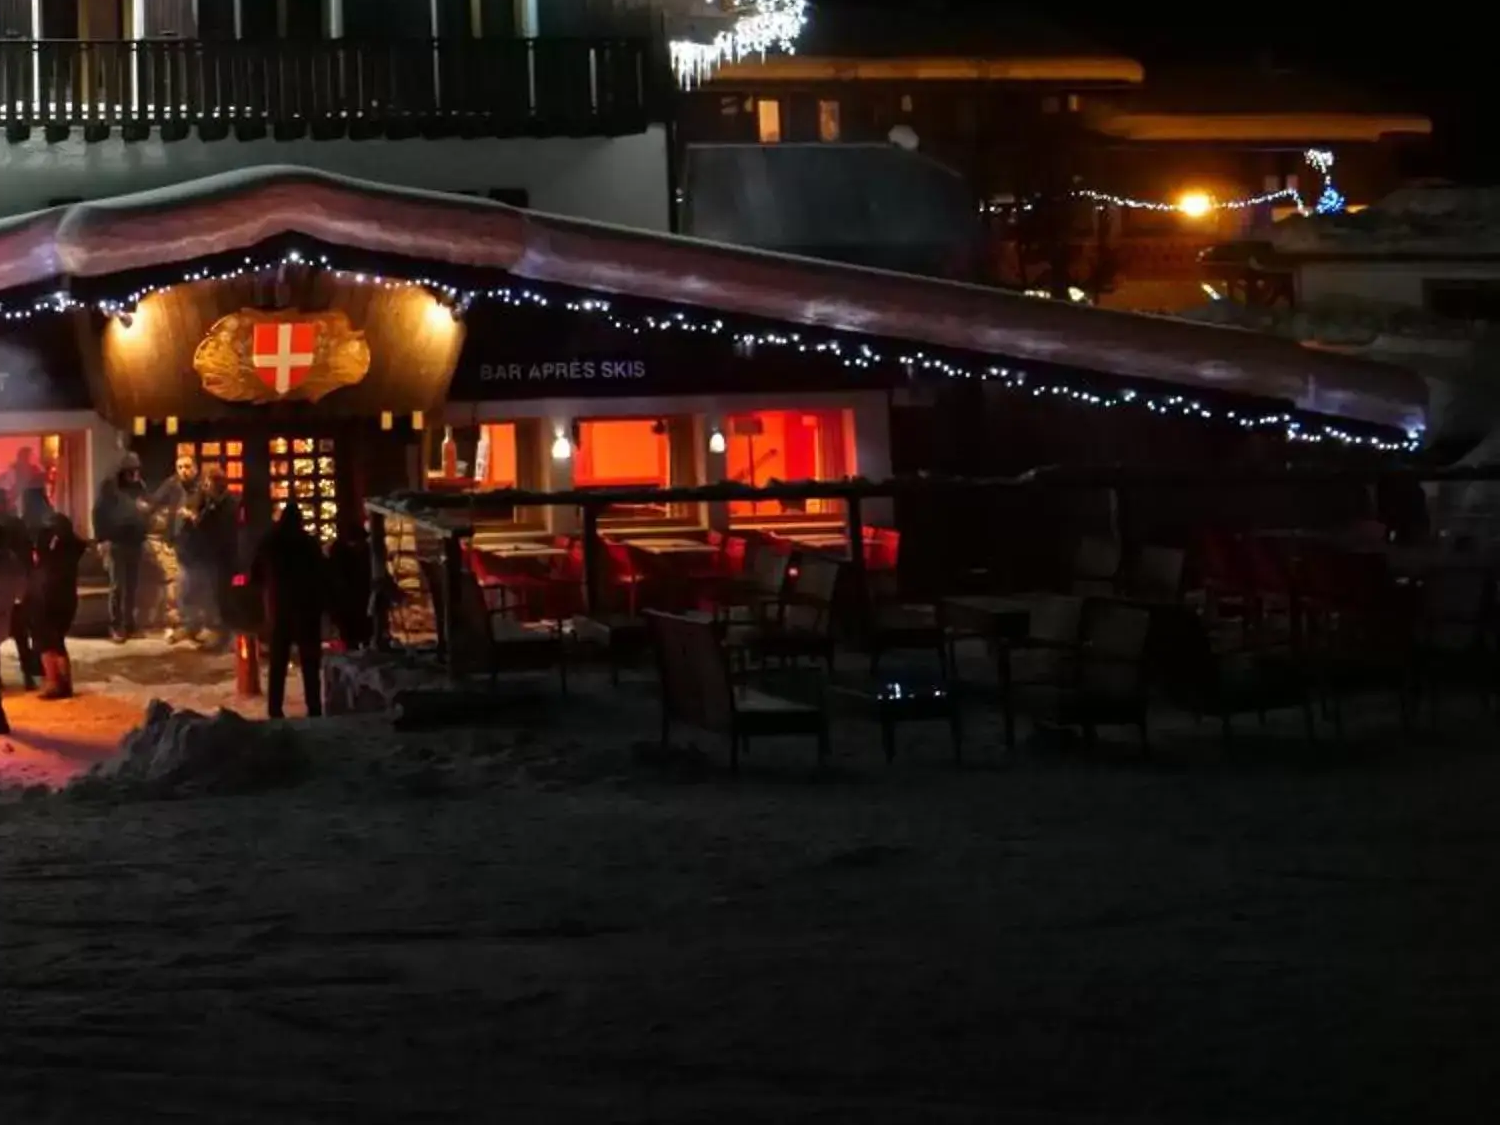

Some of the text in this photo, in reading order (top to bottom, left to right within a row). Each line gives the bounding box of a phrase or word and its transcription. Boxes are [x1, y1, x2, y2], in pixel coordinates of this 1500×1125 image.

[479, 357, 646, 382] BAR APRÈS SKIS
